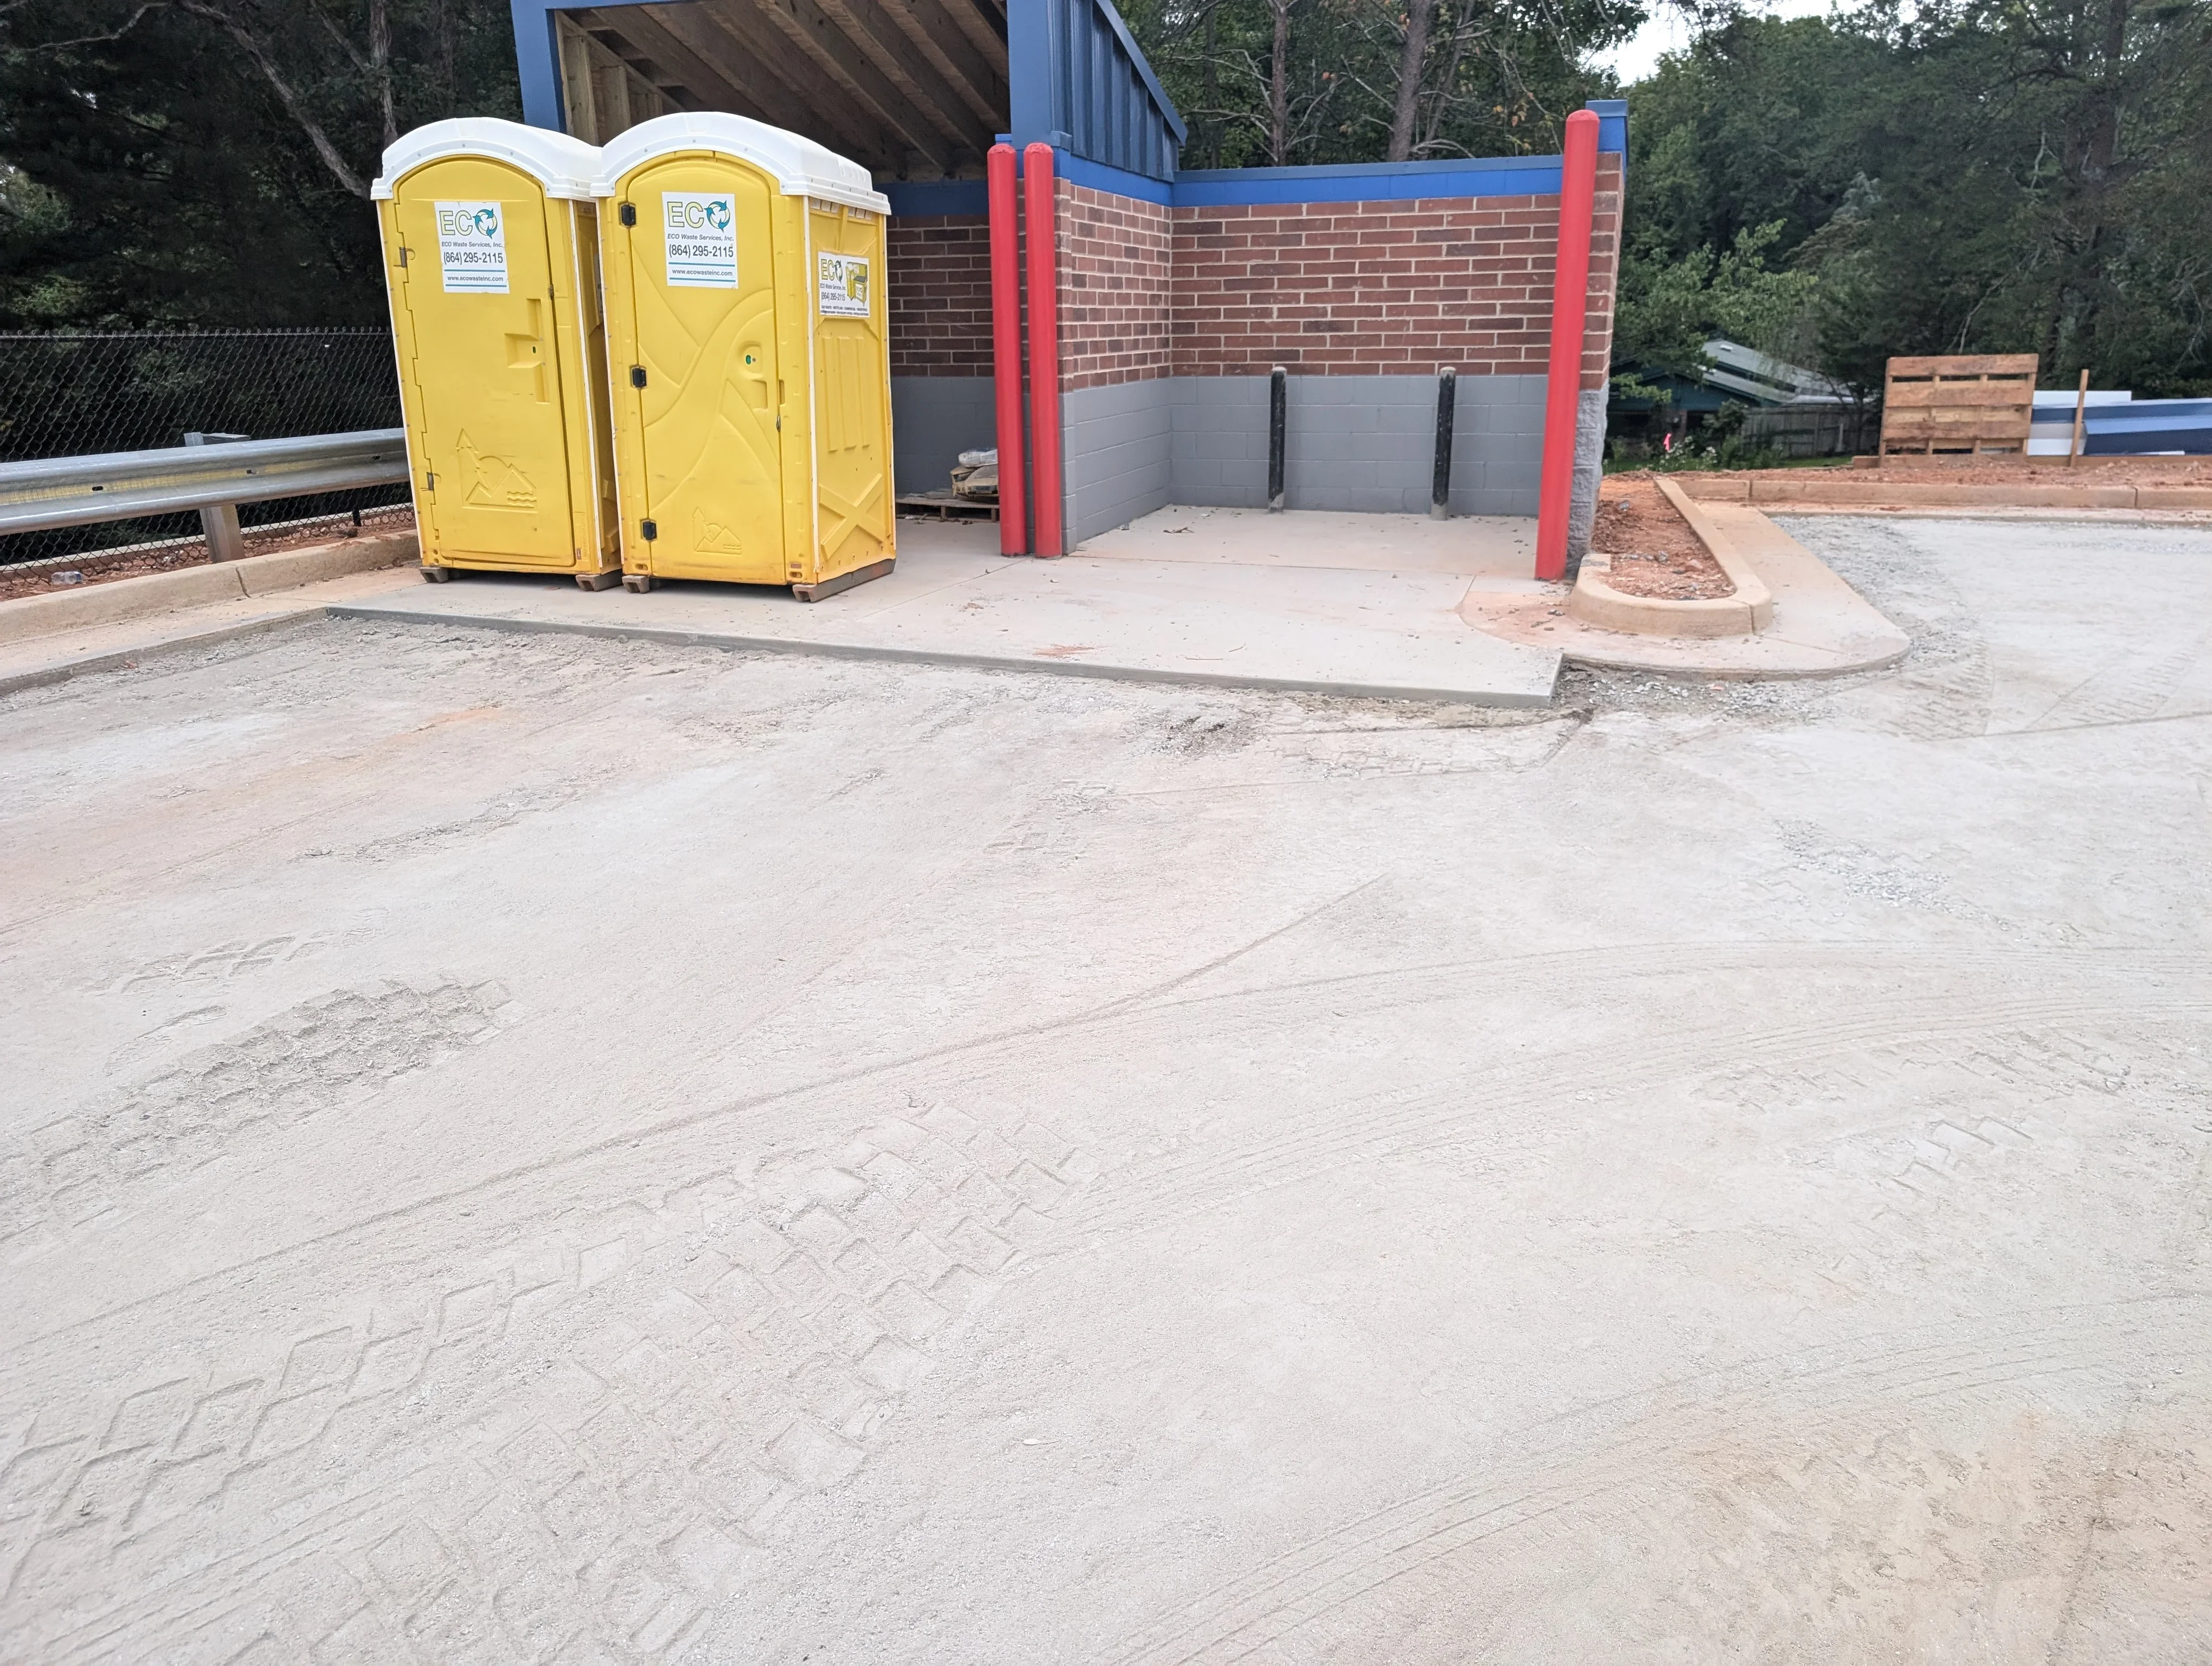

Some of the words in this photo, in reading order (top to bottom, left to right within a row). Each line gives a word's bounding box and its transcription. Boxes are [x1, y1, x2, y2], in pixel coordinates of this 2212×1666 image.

[439, 208, 498, 239] ECO
[667, 200, 730, 233] ECO
[443, 252, 462, 265] (864)
[464, 252, 503, 264] 295-2115
[669, 244, 691, 258] (864)
[692, 245, 734, 258] 295-2115
[820, 259, 843, 284] ECO
